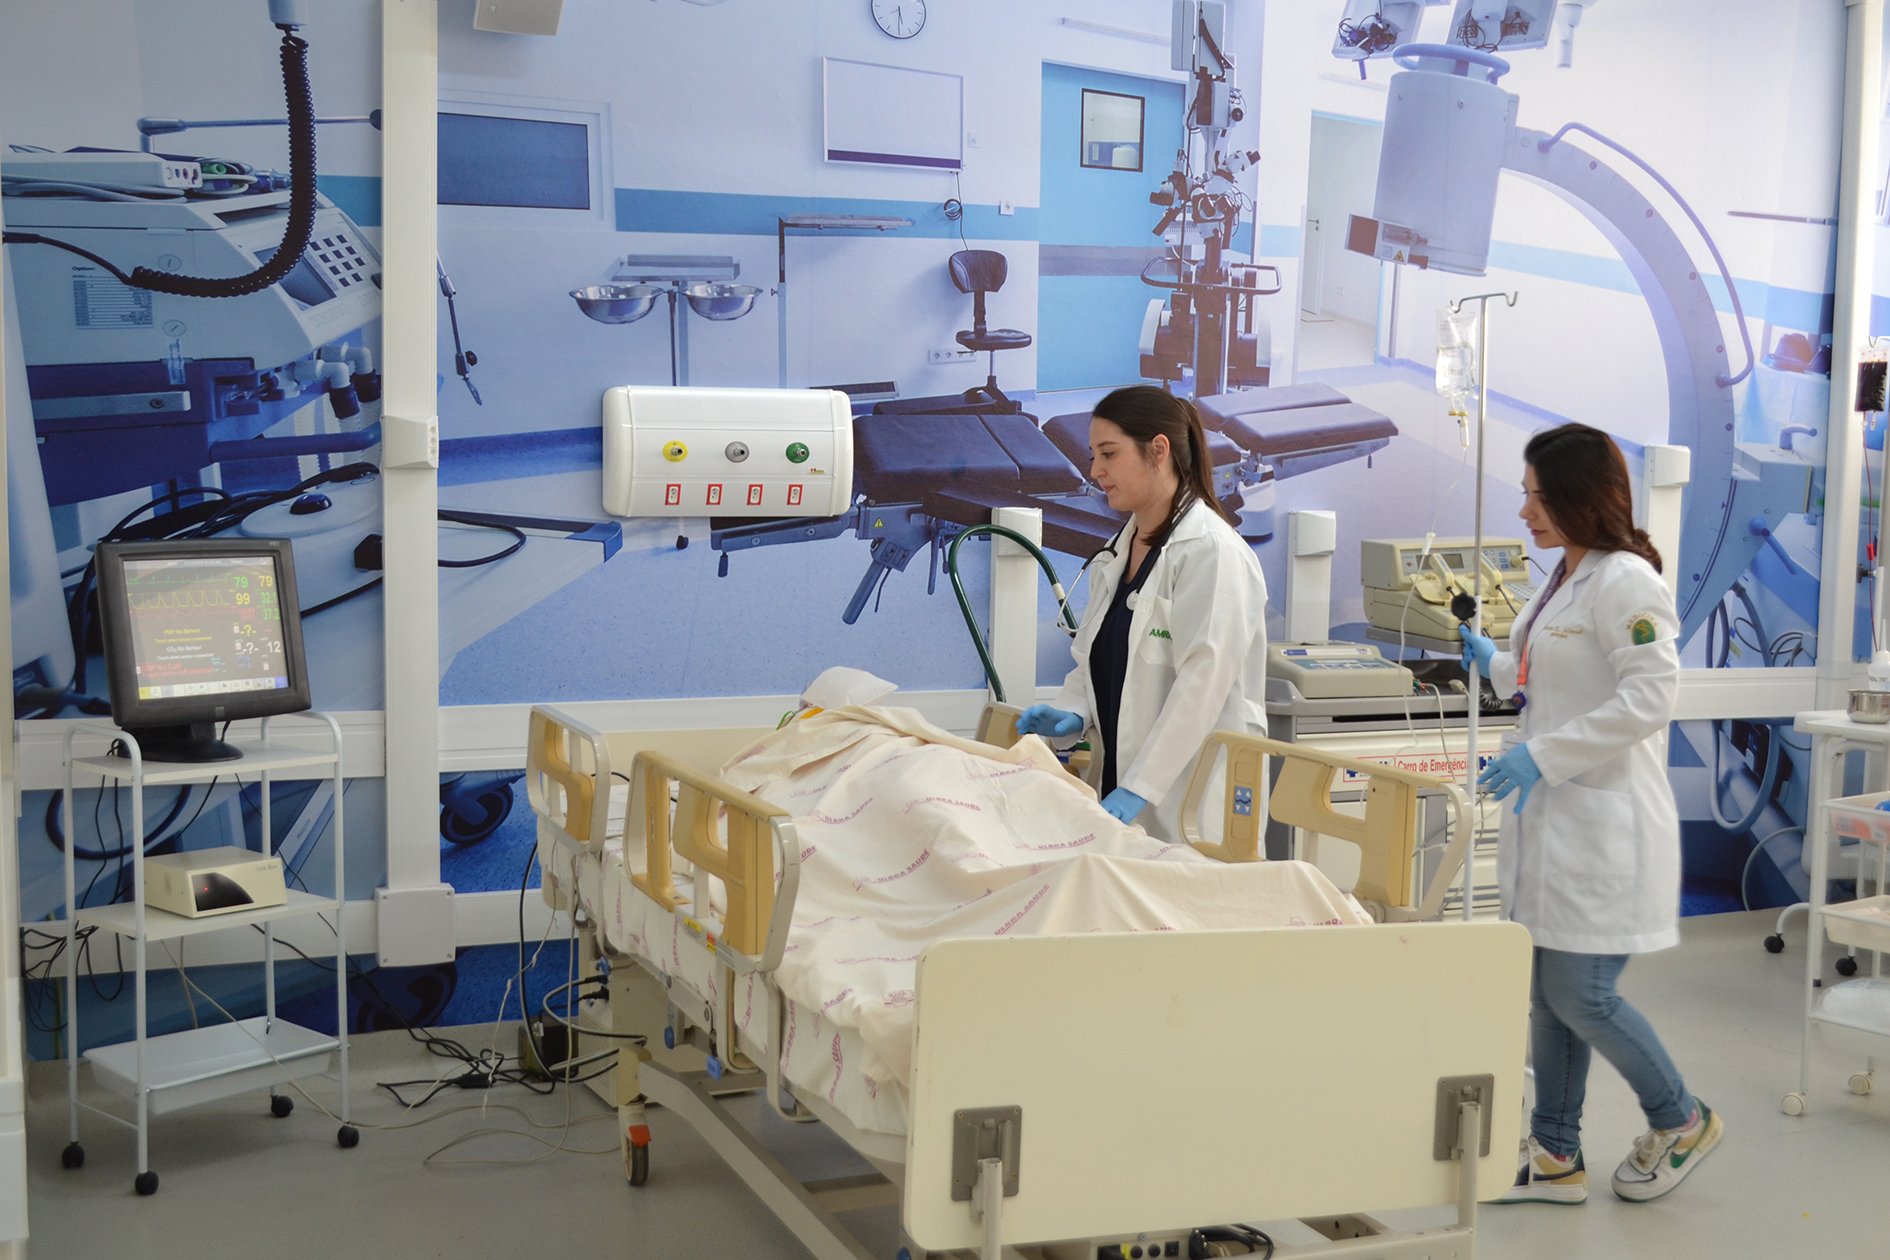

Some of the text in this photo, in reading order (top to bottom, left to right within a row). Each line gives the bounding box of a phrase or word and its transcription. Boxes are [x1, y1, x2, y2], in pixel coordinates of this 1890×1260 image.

[233, 576, 249, 588] 79
[259, 575, 273, 587] 79
[235, 592, 250, 605] 99
[267, 640, 281, 653] 12
[1398, 758, 1468, 773] Carro de Emergênci
